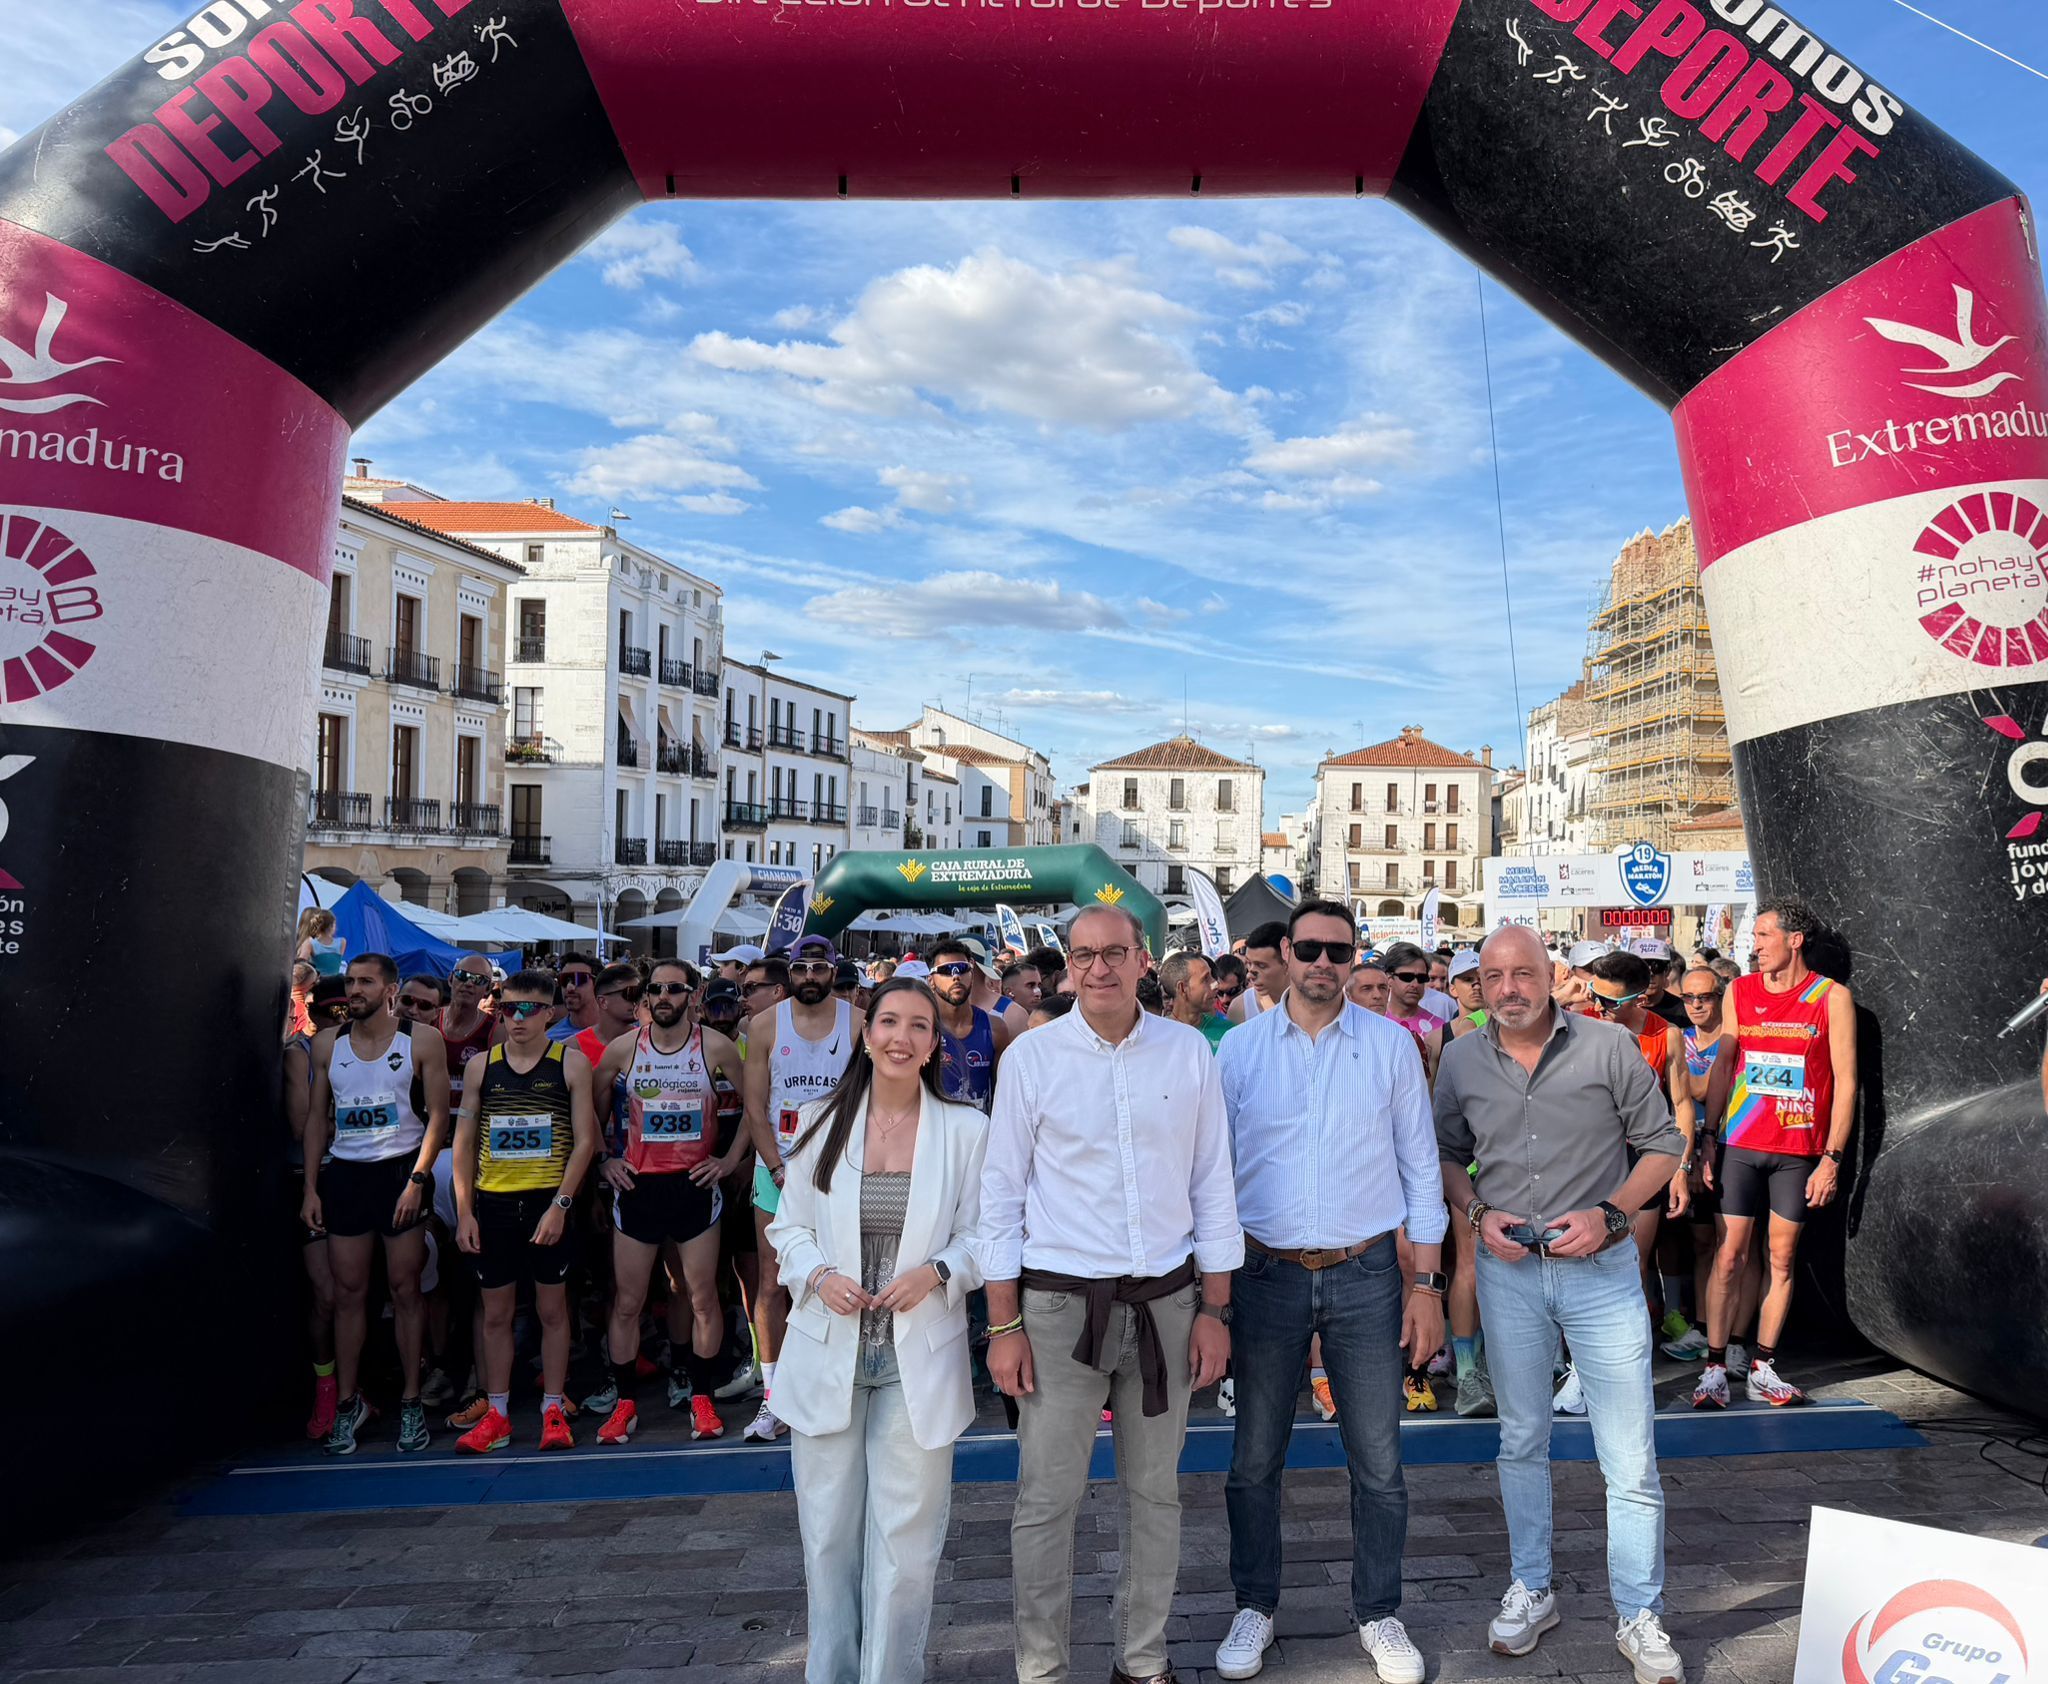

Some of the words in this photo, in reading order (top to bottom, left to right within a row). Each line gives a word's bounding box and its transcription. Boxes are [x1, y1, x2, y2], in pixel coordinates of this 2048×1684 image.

[1825, 401, 2048, 468] Extremadu
[1917, 555, 2034, 583] #nohay
[1917, 573, 2041, 607] planeta
[1636, 847, 1652, 860] 19
[931, 861, 961, 872] CAJA
[963, 859, 1005, 871] RURAL
[1007, 858, 1025, 869] DE
[1505, 866, 1535, 875] MEDIA
[1632, 865, 1658, 873] MEDIA
[757, 869, 797, 882] CHANGAN
[931, 868, 1033, 882] EXTREMADURA
[1627, 872, 1662, 880] MARATÓN
[2031, 878, 2048, 896] d
[773, 911, 802, 933] 1:30
[1424, 913, 1434, 937] chc
[1513, 914, 1534, 925] chc
[1207, 918, 1222, 945] chc
[634, 1078, 698, 1092] ECOlógicos
[784, 1075, 838, 1089] URRACAS
[1750, 1065, 1793, 1087] 264
[1776, 1101, 1815, 1113] NING
[344, 1107, 389, 1128] 405
[649, 1113, 692, 1133] 938
[497, 1130, 541, 1150] 255
[1922, 1632, 2003, 1664] Grupo
